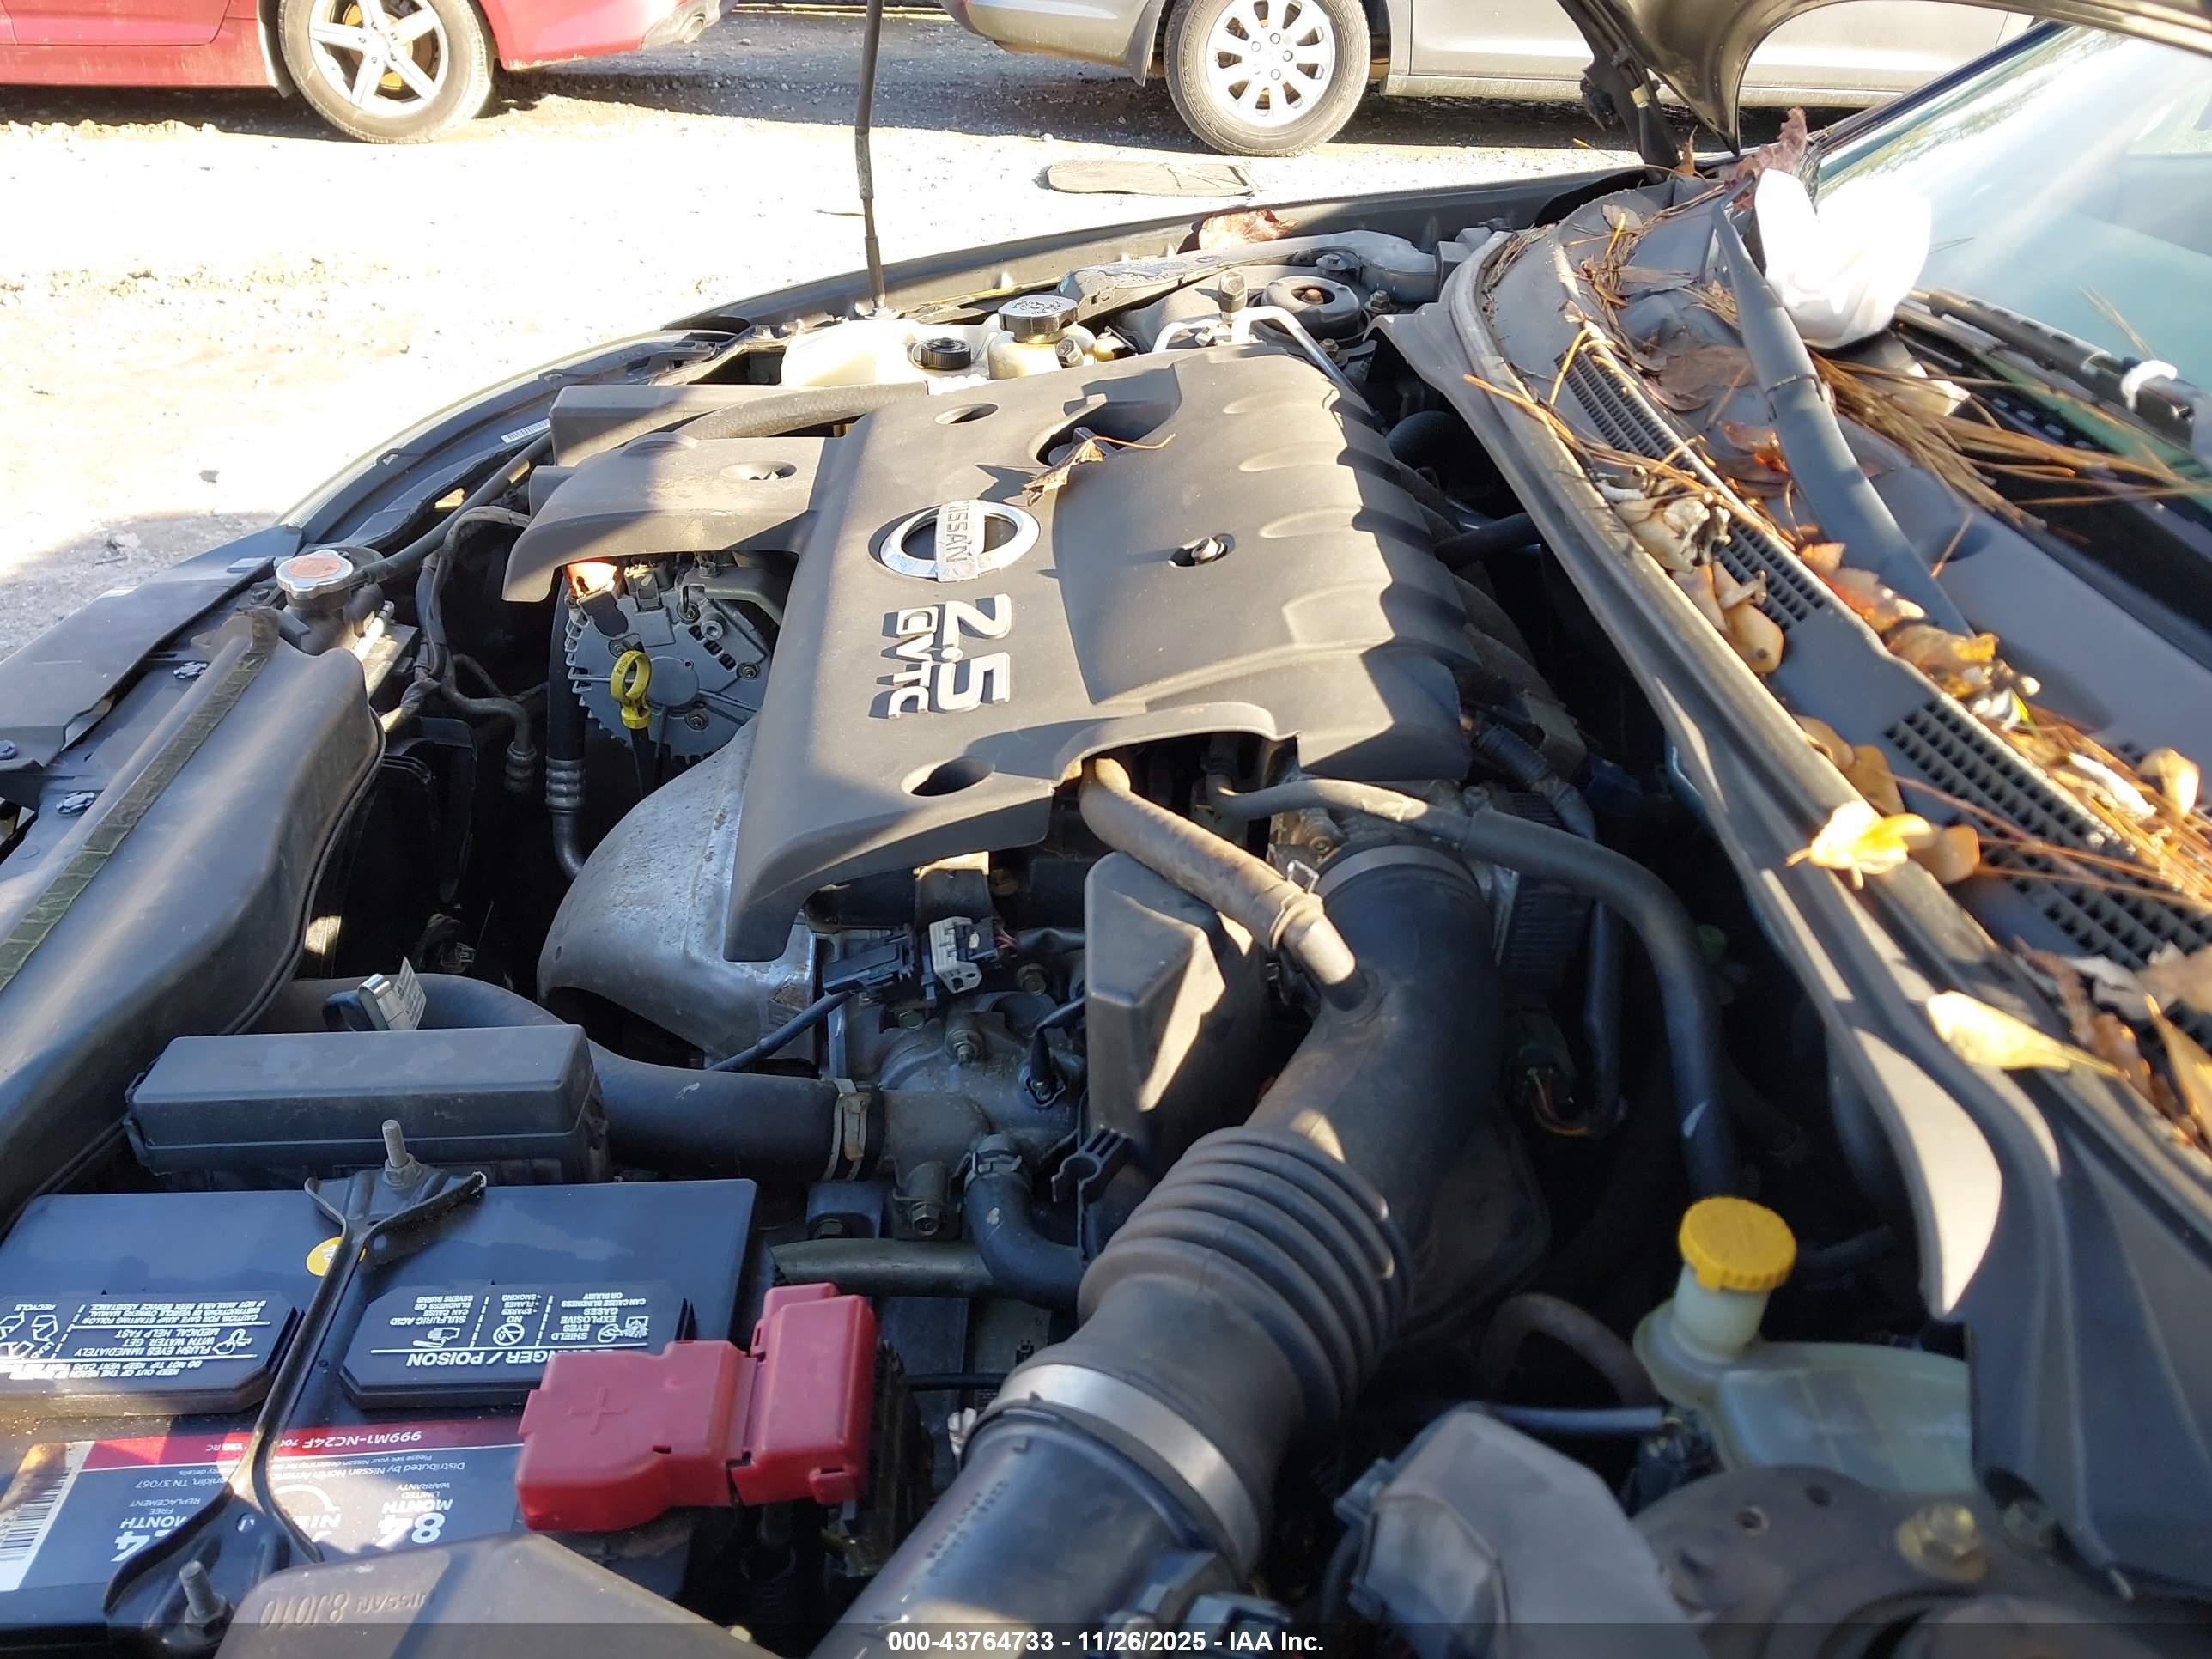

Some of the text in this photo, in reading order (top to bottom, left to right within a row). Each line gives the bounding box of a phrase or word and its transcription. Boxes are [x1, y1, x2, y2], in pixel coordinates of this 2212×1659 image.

[946, 501, 970, 563] NISSAN
[937, 593, 1012, 712] 2.5
[888, 606, 939, 720] CVTC
[415, 1316, 466, 1325] SULFURIC
[560, 1315, 617, 1324] EXPLOSIVE
[562, 1323, 590, 1332] EYES
[114, 1329, 143, 1338] FAST
[143, 1329, 173, 1338] HELP
[120, 1338, 144, 1346] GET
[187, 1337, 215, 1346] WITH
[74, 1346, 211, 1357] FLUSH EYES IMMEDIATELY
[406, 1352, 485, 1366] POISON
[302, 1431, 422, 1449] 999M1-NC24F
[348, 1468, 386, 1476] Nissan
[403, 1462, 465, 1473] Distributed
[309, 1469, 347, 1479] North
[396, 1482, 450, 1491] WARRANTY
[129, 1498, 201, 1507] REPLACEMENT
[381, 1498, 453, 1514] MONTH
[292, 1513, 341, 1528] NIS
[376, 1512, 445, 1548] 84
